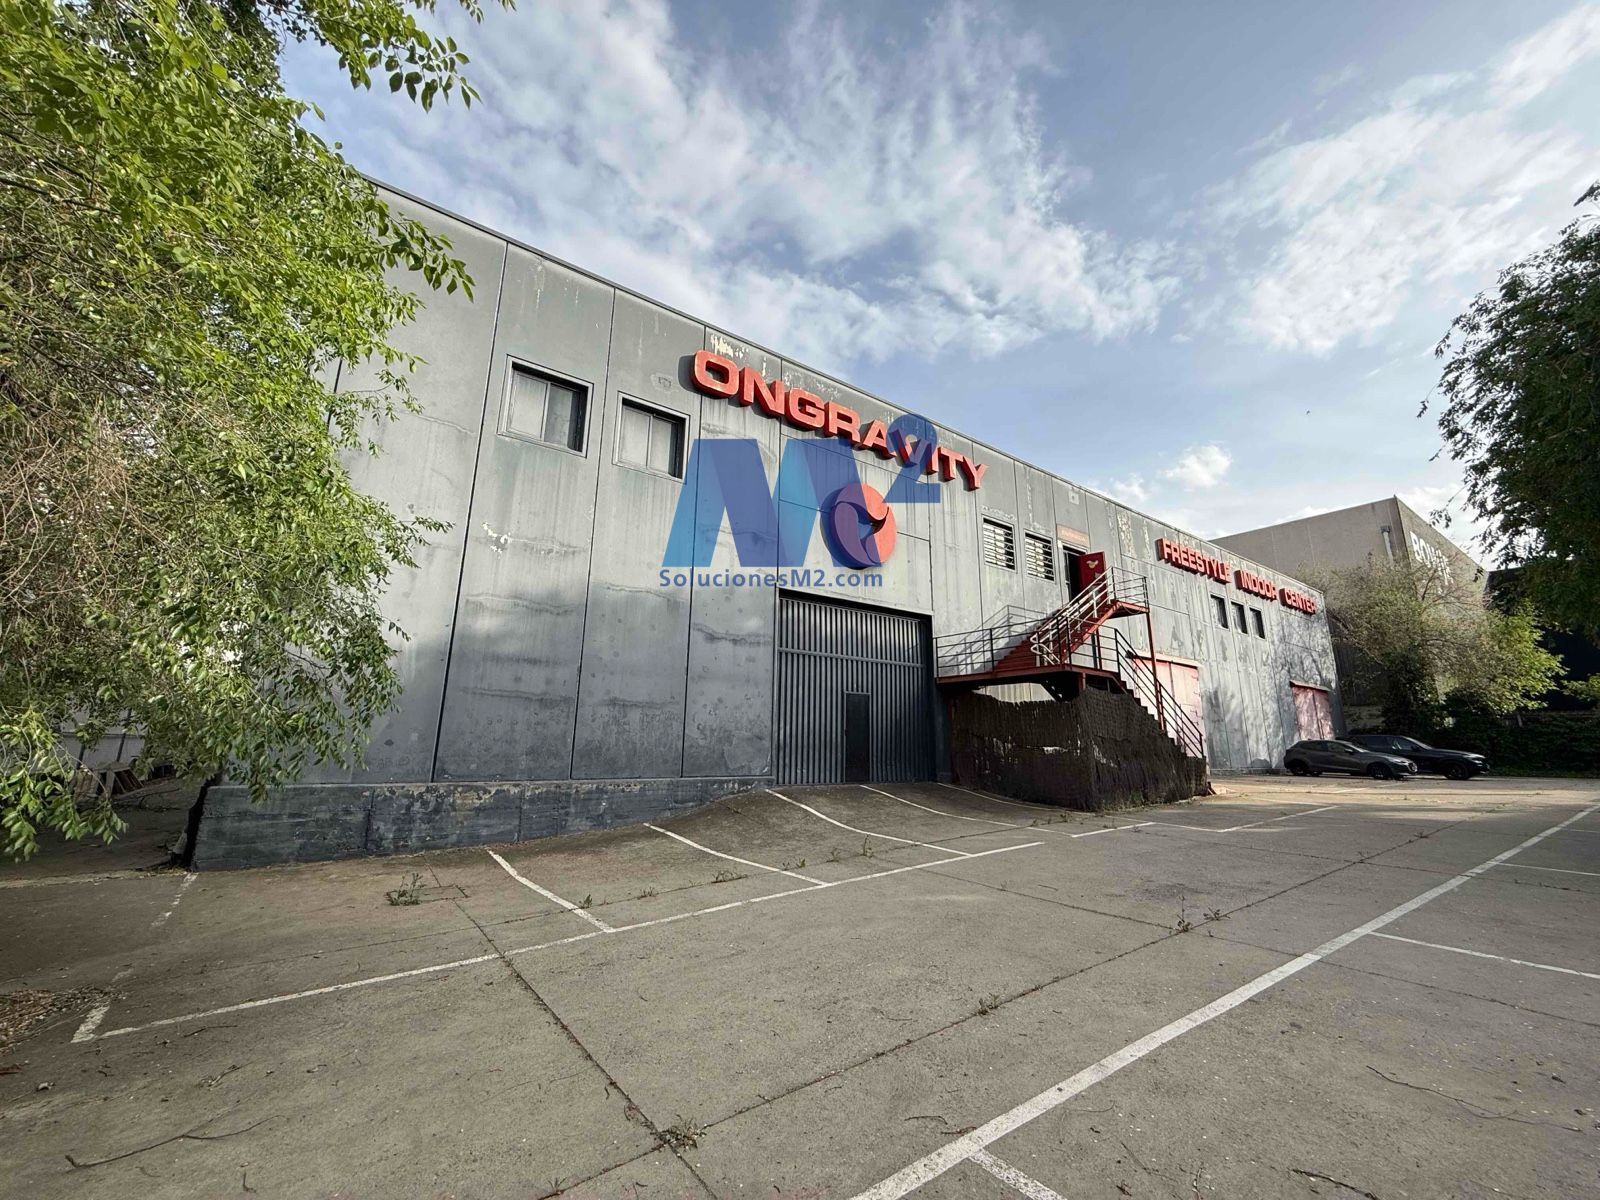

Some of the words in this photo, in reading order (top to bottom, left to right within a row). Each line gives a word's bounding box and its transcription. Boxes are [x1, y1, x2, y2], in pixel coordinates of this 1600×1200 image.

[691, 349, 988, 492] ONGRAVITY
[1159, 537, 1232, 584] FREESTYLE
[1237, 569, 1277, 601] INDOOR
[1281, 587, 1317, 615] CENTER
